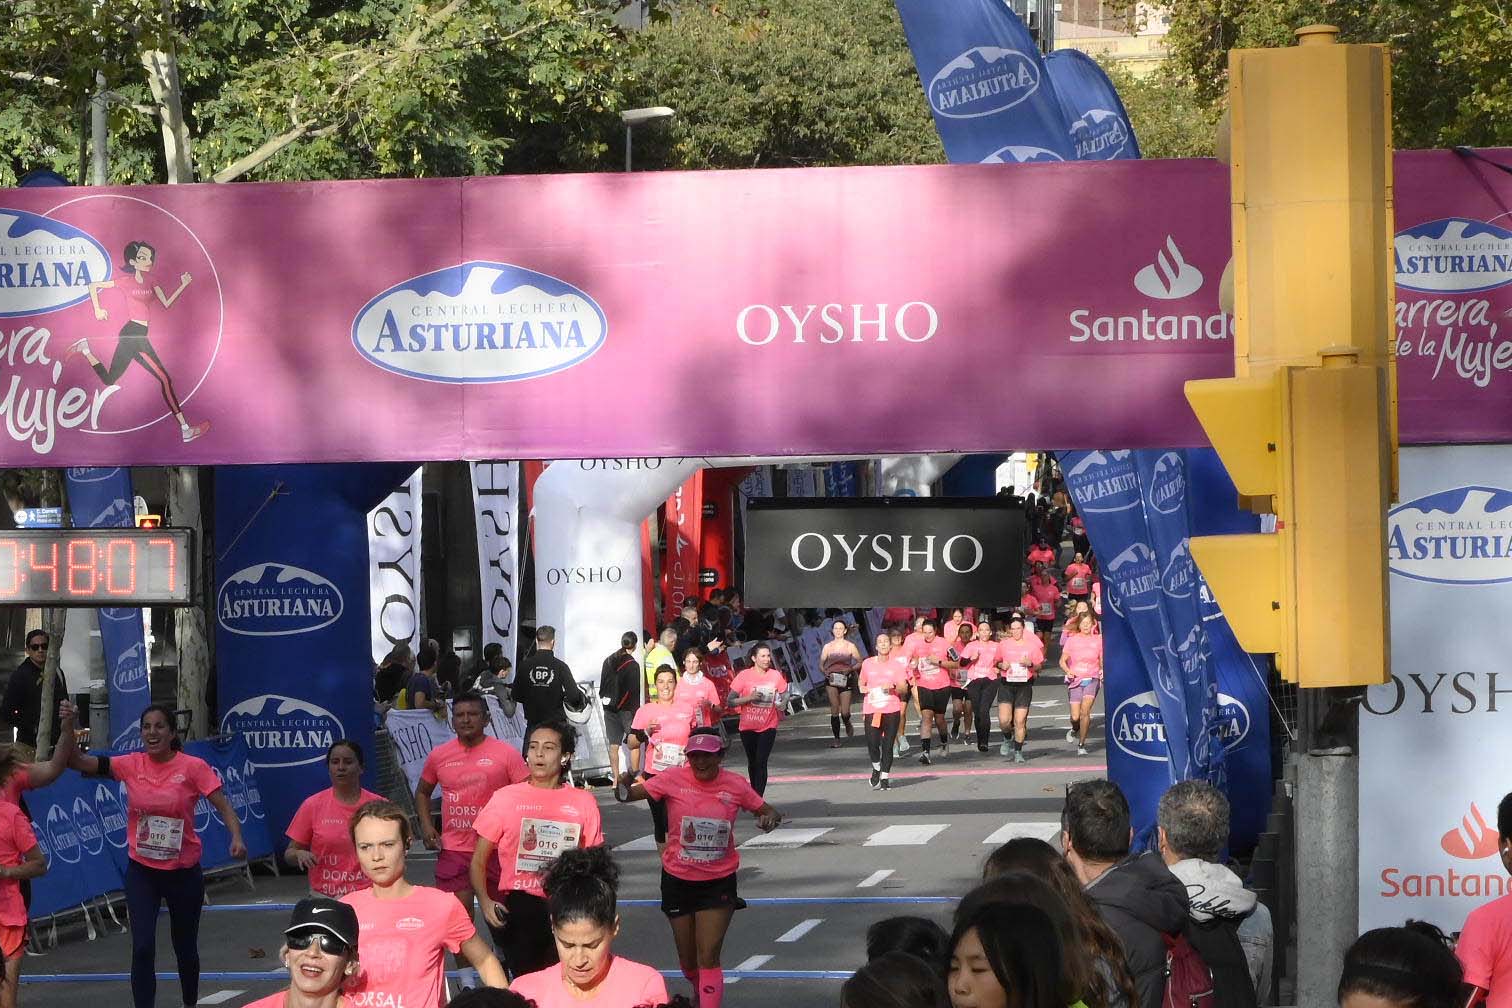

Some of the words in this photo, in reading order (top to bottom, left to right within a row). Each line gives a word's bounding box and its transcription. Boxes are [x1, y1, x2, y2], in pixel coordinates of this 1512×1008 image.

[14, 244, 87, 257] LECHERA
[411, 303, 487, 317] CENTRAL
[498, 301, 579, 315] LECHERA
[735, 301, 938, 345] OYSHO
[371, 309, 587, 354] ASTURIANA
[1418, 330, 1436, 356] la
[1416, 520, 1482, 532] CENTRAL
[790, 532, 983, 574] OYSHO
[546, 565, 622, 586] OYSHO
[234, 587, 277, 596] CENTRAL
[281, 587, 330, 596] LECHERA
[221, 593, 334, 620] ASTURIANA
[535, 670, 549, 680] BP
[449, 793, 459, 803] TU
[538, 841, 558, 850] 016
[322, 855, 337, 866] TU
